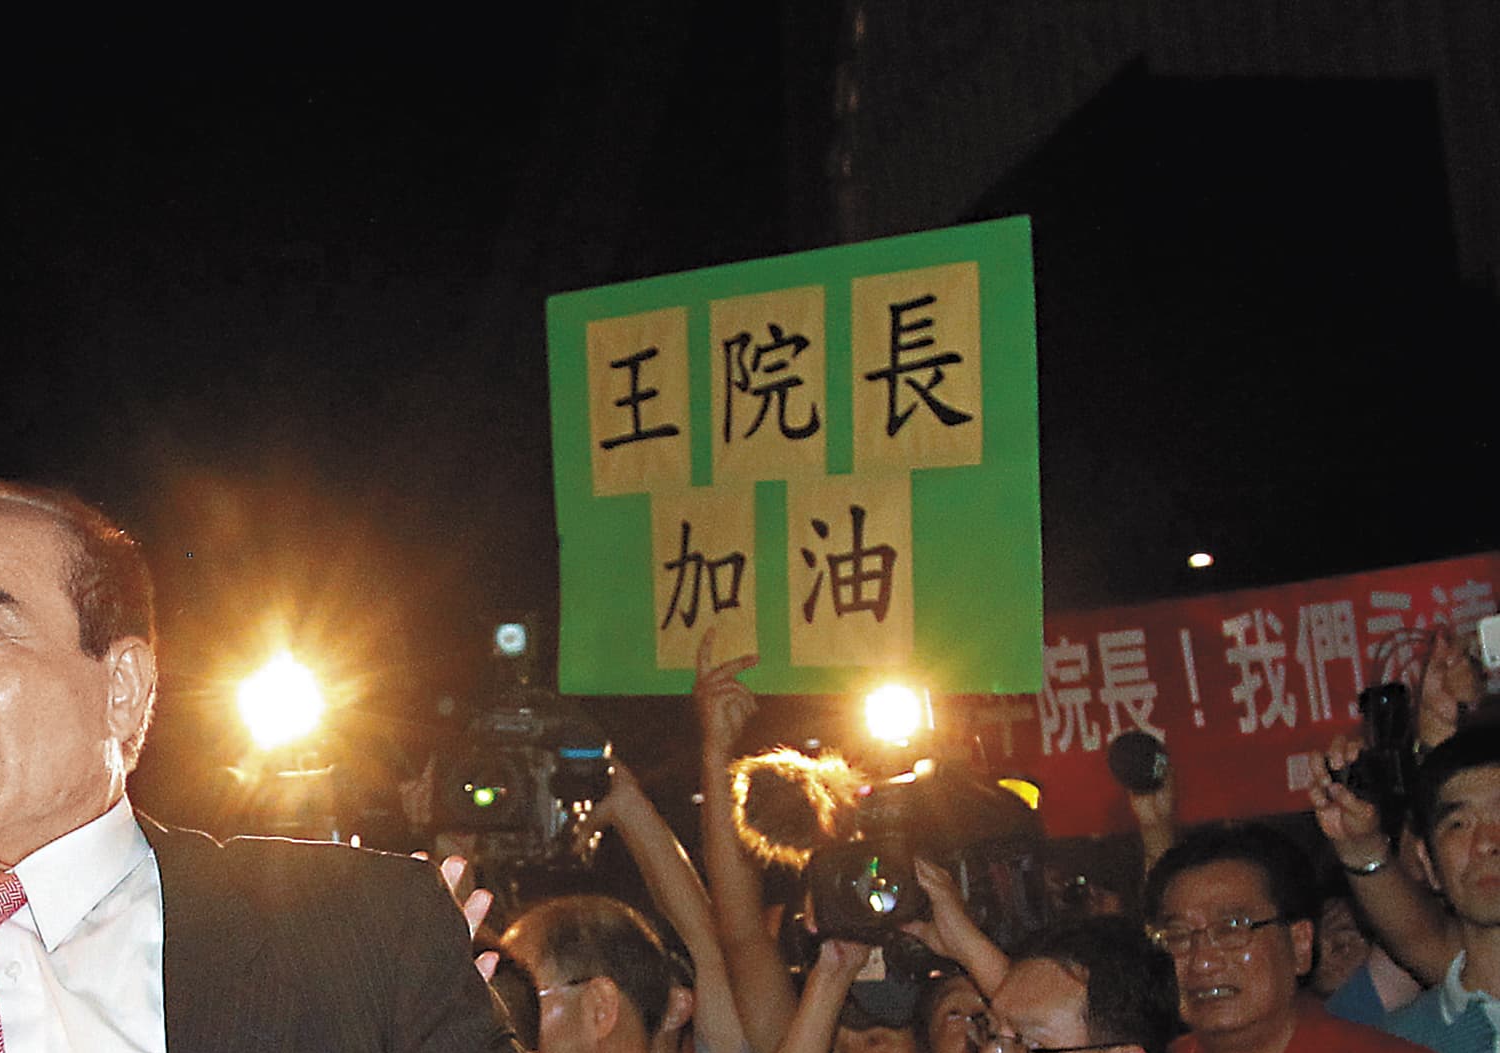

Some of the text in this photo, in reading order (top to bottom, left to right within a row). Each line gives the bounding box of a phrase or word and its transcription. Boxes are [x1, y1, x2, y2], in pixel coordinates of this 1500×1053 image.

[600, 294, 973, 451] 王院長
[661, 504, 897, 631] 加油
